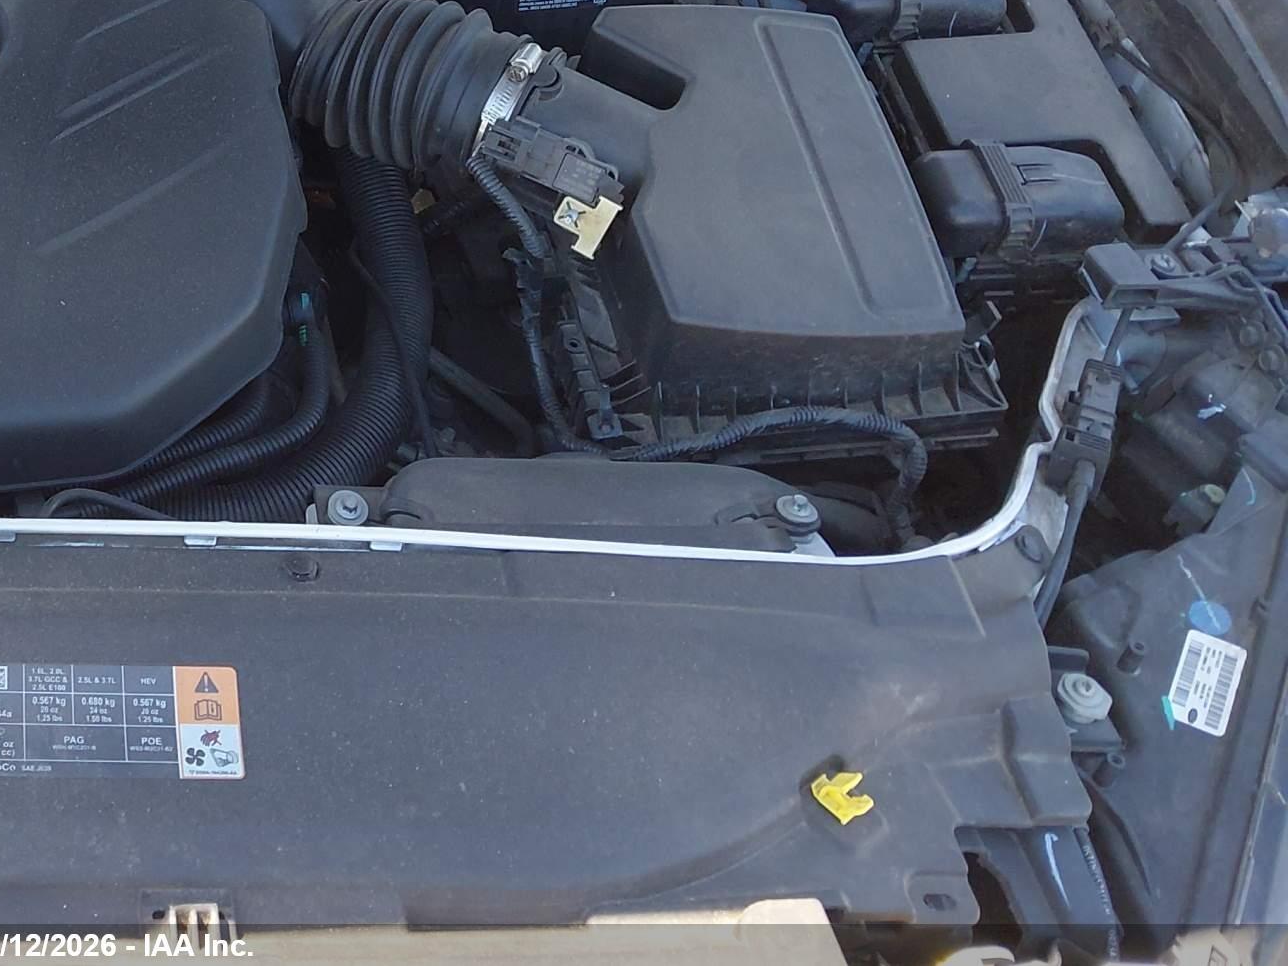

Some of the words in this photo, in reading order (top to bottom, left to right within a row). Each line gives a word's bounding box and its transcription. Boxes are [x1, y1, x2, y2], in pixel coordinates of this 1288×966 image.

[140, 677, 157, 685] HEV
[31, 696, 54, 705] 0.567
[55, 696, 66, 707] kg
[105, 697, 116, 708] kg
[156, 698, 167, 709] kg
[3, 740, 14, 748] oz
[63, 735, 85, 744] PAG
[141, 737, 163, 745] POE
[0, 748, 16, 757] cc)
